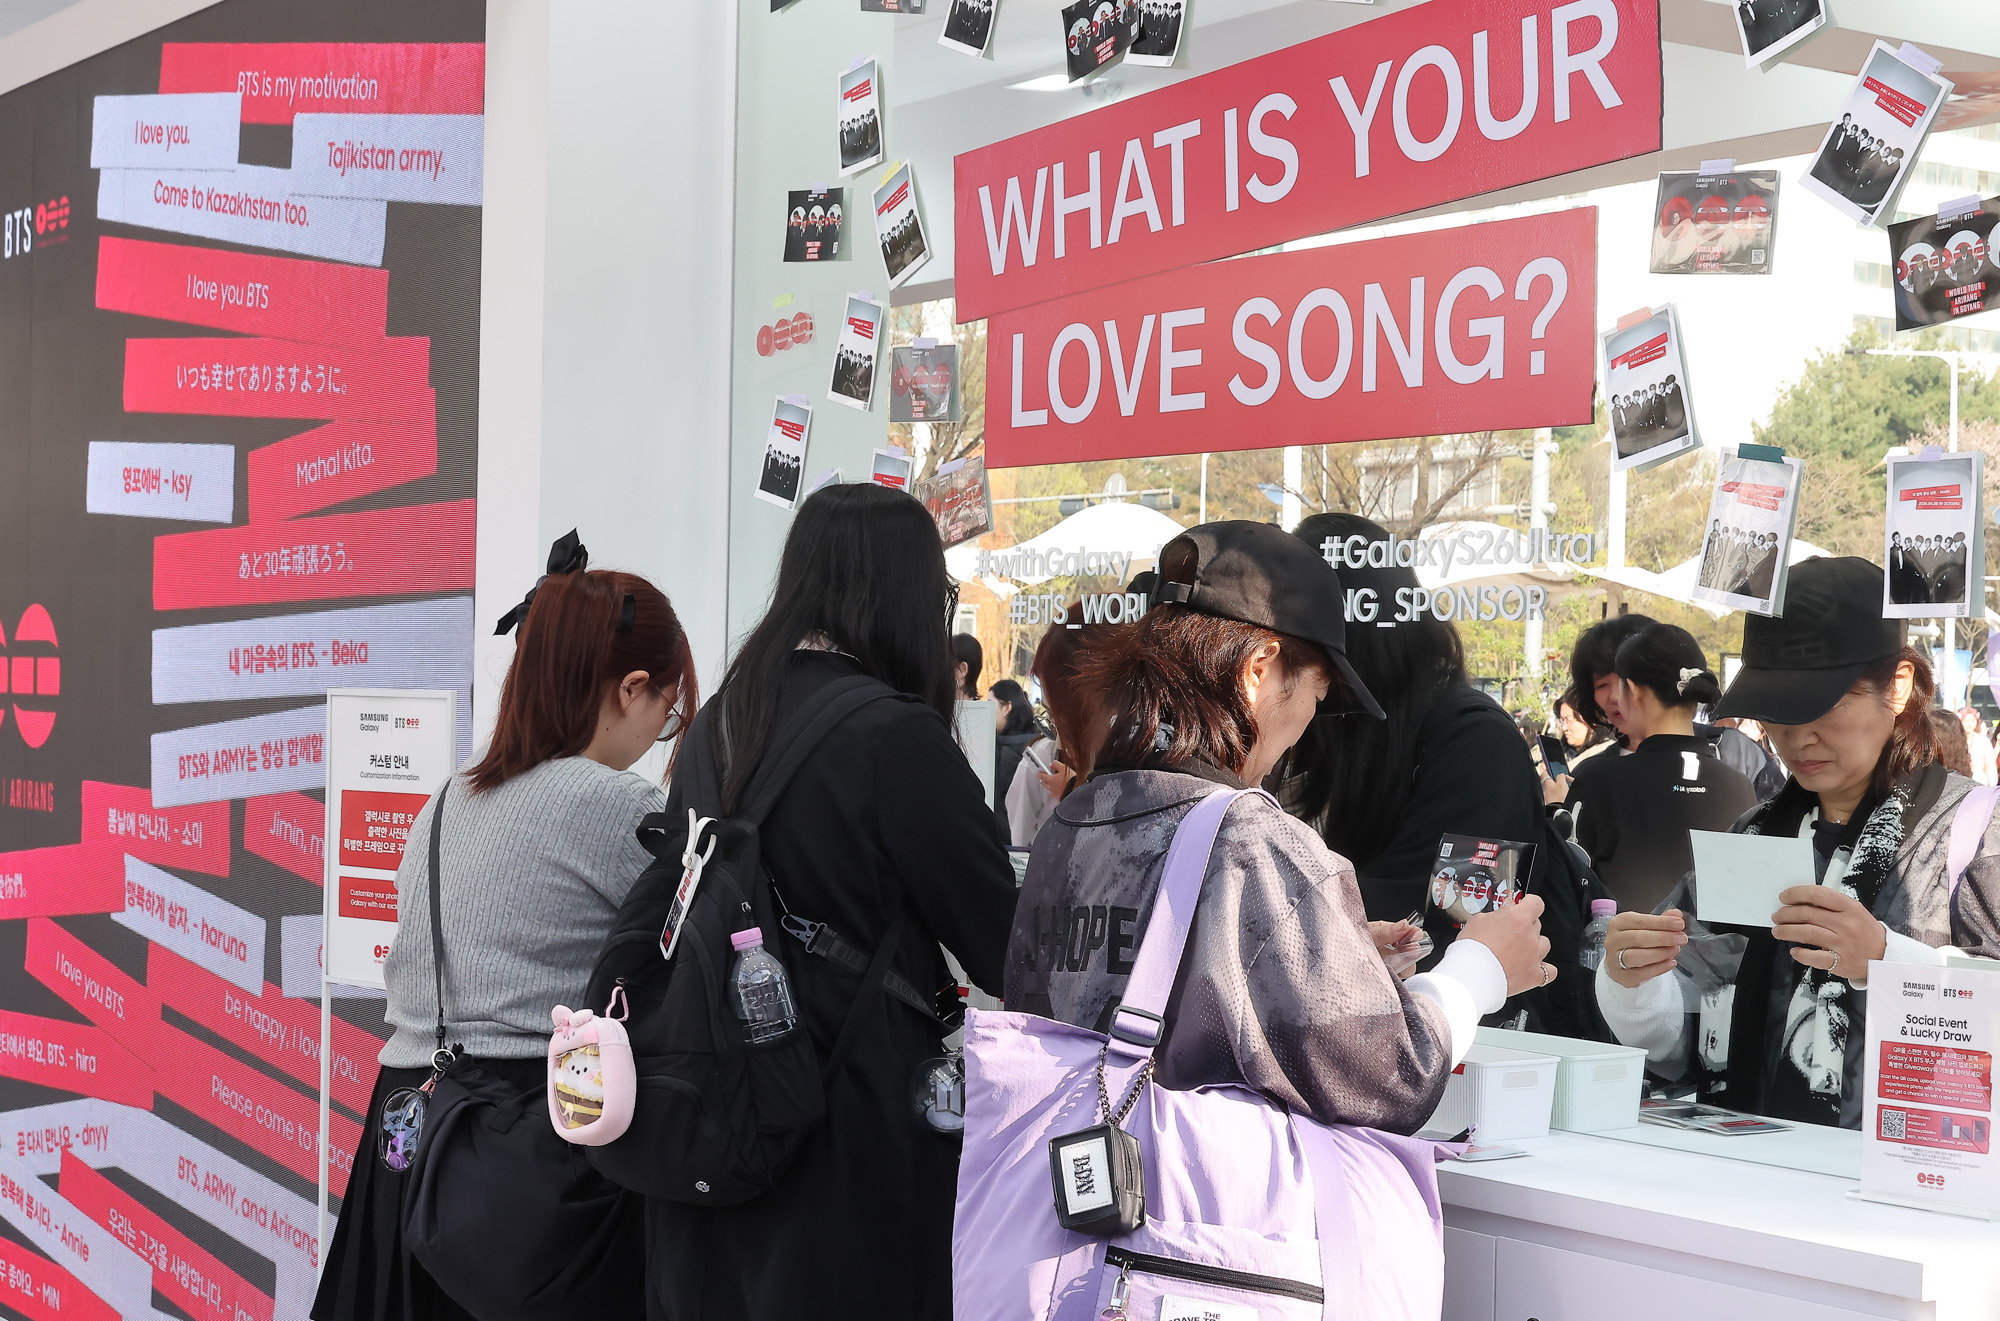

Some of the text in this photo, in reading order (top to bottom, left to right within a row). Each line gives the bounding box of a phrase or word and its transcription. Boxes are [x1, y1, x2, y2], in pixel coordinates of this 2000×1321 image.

[238, 70, 378, 106] BTS is my motivation
[134, 120, 190, 152] I love you.
[977, 0, 1624, 277] WHAT IS YOUR
[328, 140, 445, 181] Tajikistan army.
[154, 179, 309, 227] Come to Kazakhstan too.
[1964, 212, 1974, 221] BTS
[4, 206, 32, 259] BTS
[1936, 223, 1952, 231] Galaxy
[186, 273, 270, 311] I love you BTS
[1949, 282, 1982, 298] WORLD TOUR
[1954, 293, 1978, 306] ARIRANG
[1952, 302, 1980, 316] IN GOYANG
[1010, 256, 1569, 429] LOVE SONG?
[177, 362, 347, 395] いつも幸せでありますように。
[296, 441, 376, 488] Mahal kita.
[122, 466, 192, 502] 영포에버 ksy
[239, 541, 354, 580] あと30年頑張ろう。
[975, 546, 1133, 586] #withGalaxy
[1319, 527, 1596, 578] #GalaxyS26Ultra
[1009, 584, 1548, 629] #BTS_WORL NG_SPONSOR
[229, 639, 368, 676] 내 마음속의 BTS. Beka
[360, 713, 405, 729] SAMSUNG BTS
[360, 724, 380, 733] Galaxy
[178, 750, 210, 780] BTS와
[213, 744, 258, 775] ARMY는
[260, 738, 284, 770] 항상
[360, 771, 420, 781] Customization Information
[370, 754, 409, 769] 커스텀 안내
[9, 778, 54, 812] ARIRANG
[108, 807, 202, 849] 봄날에 만나자. 소미
[269, 811, 307, 854] Jimin,
[364, 810, 414, 825] 갤럭시로 촬영 후
[367, 826, 409, 840] 출력한 사진을
[343, 839, 396, 854] 특별한 프레임으로
[350, 889, 399, 901] Customize your photo
[351, 899, 367, 908] Galaxy
[126, 880, 248, 964] 행복하게 살자. haruna
[1024, 905, 1138, 976] J-HOPE
[56, 950, 126, 1021] I love you BTS.
[1902, 990, 1924, 999] Galaxy
[1903, 982, 1956, 997] SAMSUNG BTS
[224, 990, 360, 1084] be happy, I lov you.
[1900, 1026, 1972, 1042] & Lucky Draw
[1906, 1014, 1968, 1029] Social Event
[47, 1042, 68, 1068] BTS.
[75, 1048, 97, 1074] hira
[1887, 1054, 1907, 1062] Galaxy
[211, 1074, 313, 1151] Please come to
[16, 1130, 26, 1158] 곧
[27, 1128, 44, 1155] 다시
[82, 1122, 109, 1152] dnyy
[0, 1172, 24, 1212] 행복해
[60, 1222, 90, 1263] Annie
[178, 1154, 319, 1269] BTS, ARMY, and Arirang
[108, 1208, 137, 1250] 우리는
[138, 1229, 168, 1274] 그것을
[170, 1253, 224, 1314] 사랑합니다.
[8, 1263, 60, 1312] 좋아요 MIN
[1204, 1311, 1221, 1320] THE
